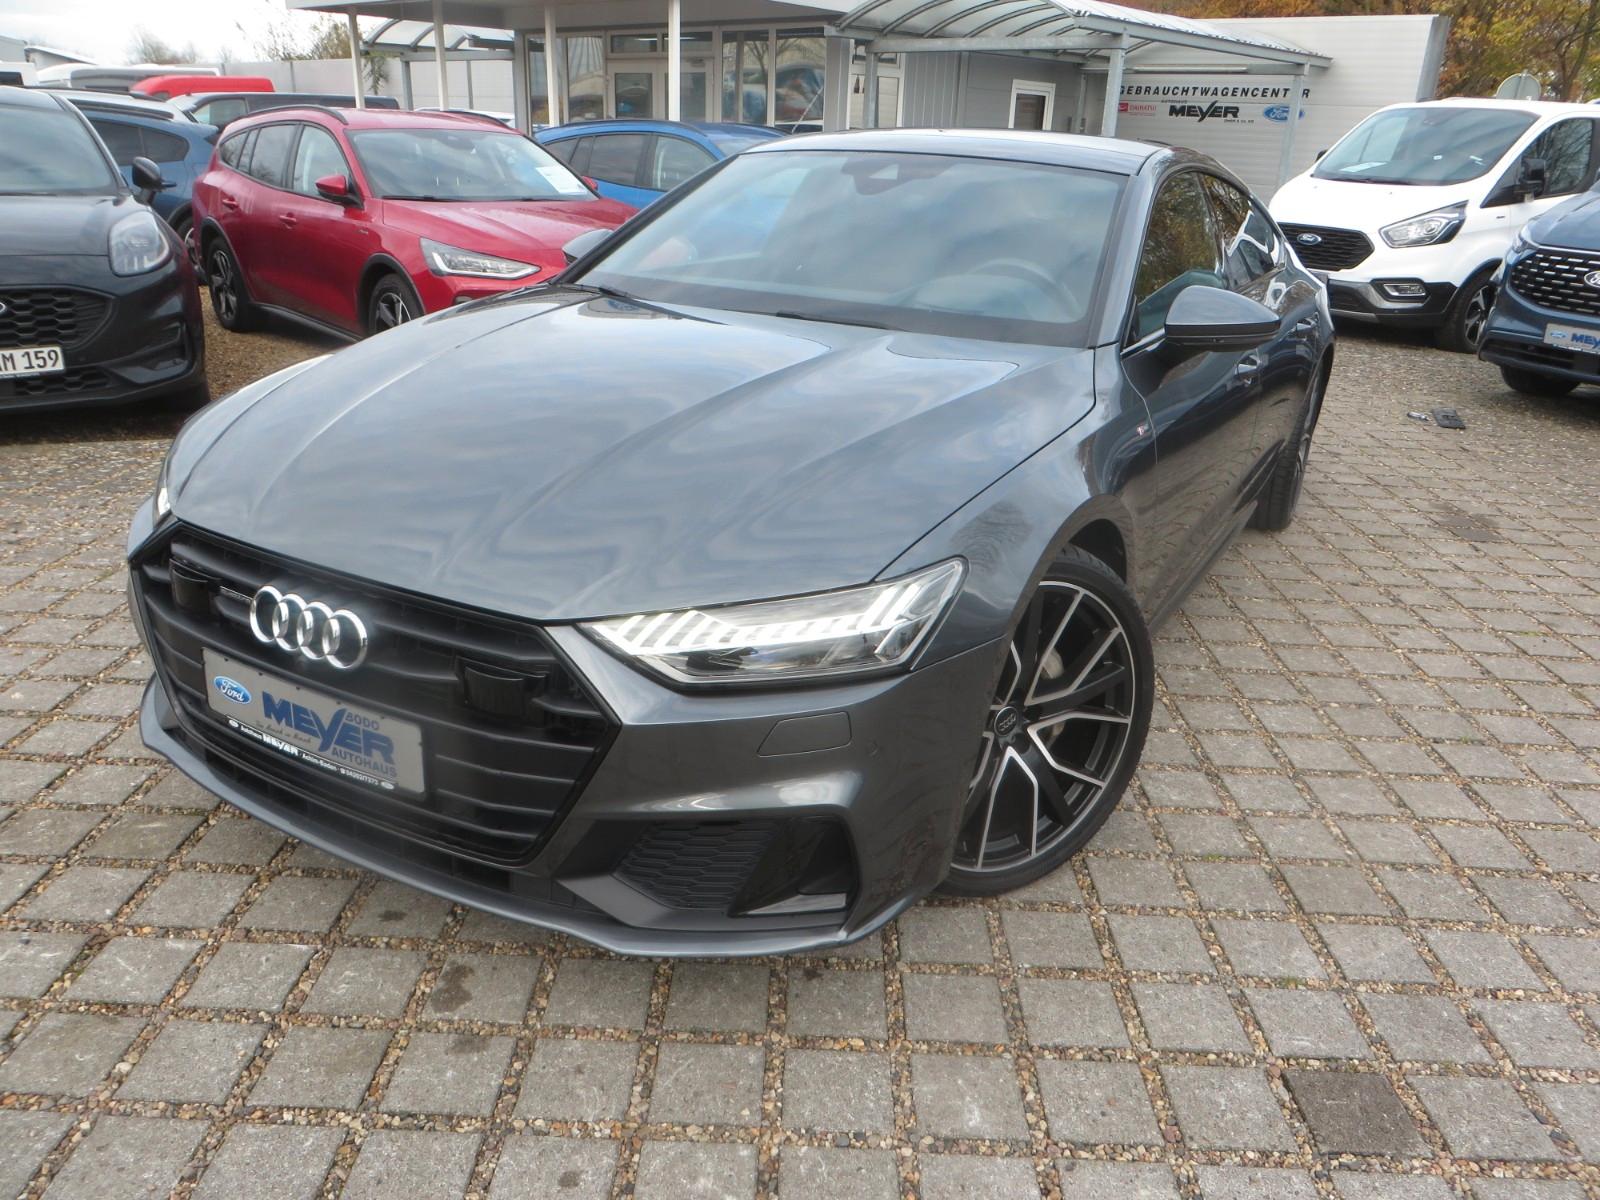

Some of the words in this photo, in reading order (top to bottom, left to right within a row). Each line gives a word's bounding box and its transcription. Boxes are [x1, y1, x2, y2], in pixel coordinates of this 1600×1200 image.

[1120, 86, 1310, 98] GEBRAUCHTWAGENCENTR
[1168, 100, 1239, 122] MEYER
[0, 353, 16, 371] M
[21, 350, 59, 369] 159
[221, 680, 244, 701] Ford
[262, 691, 395, 765] MEYER
[345, 711, 379, 730] BODO
[331, 746, 398, 778] AUTOHAUS
